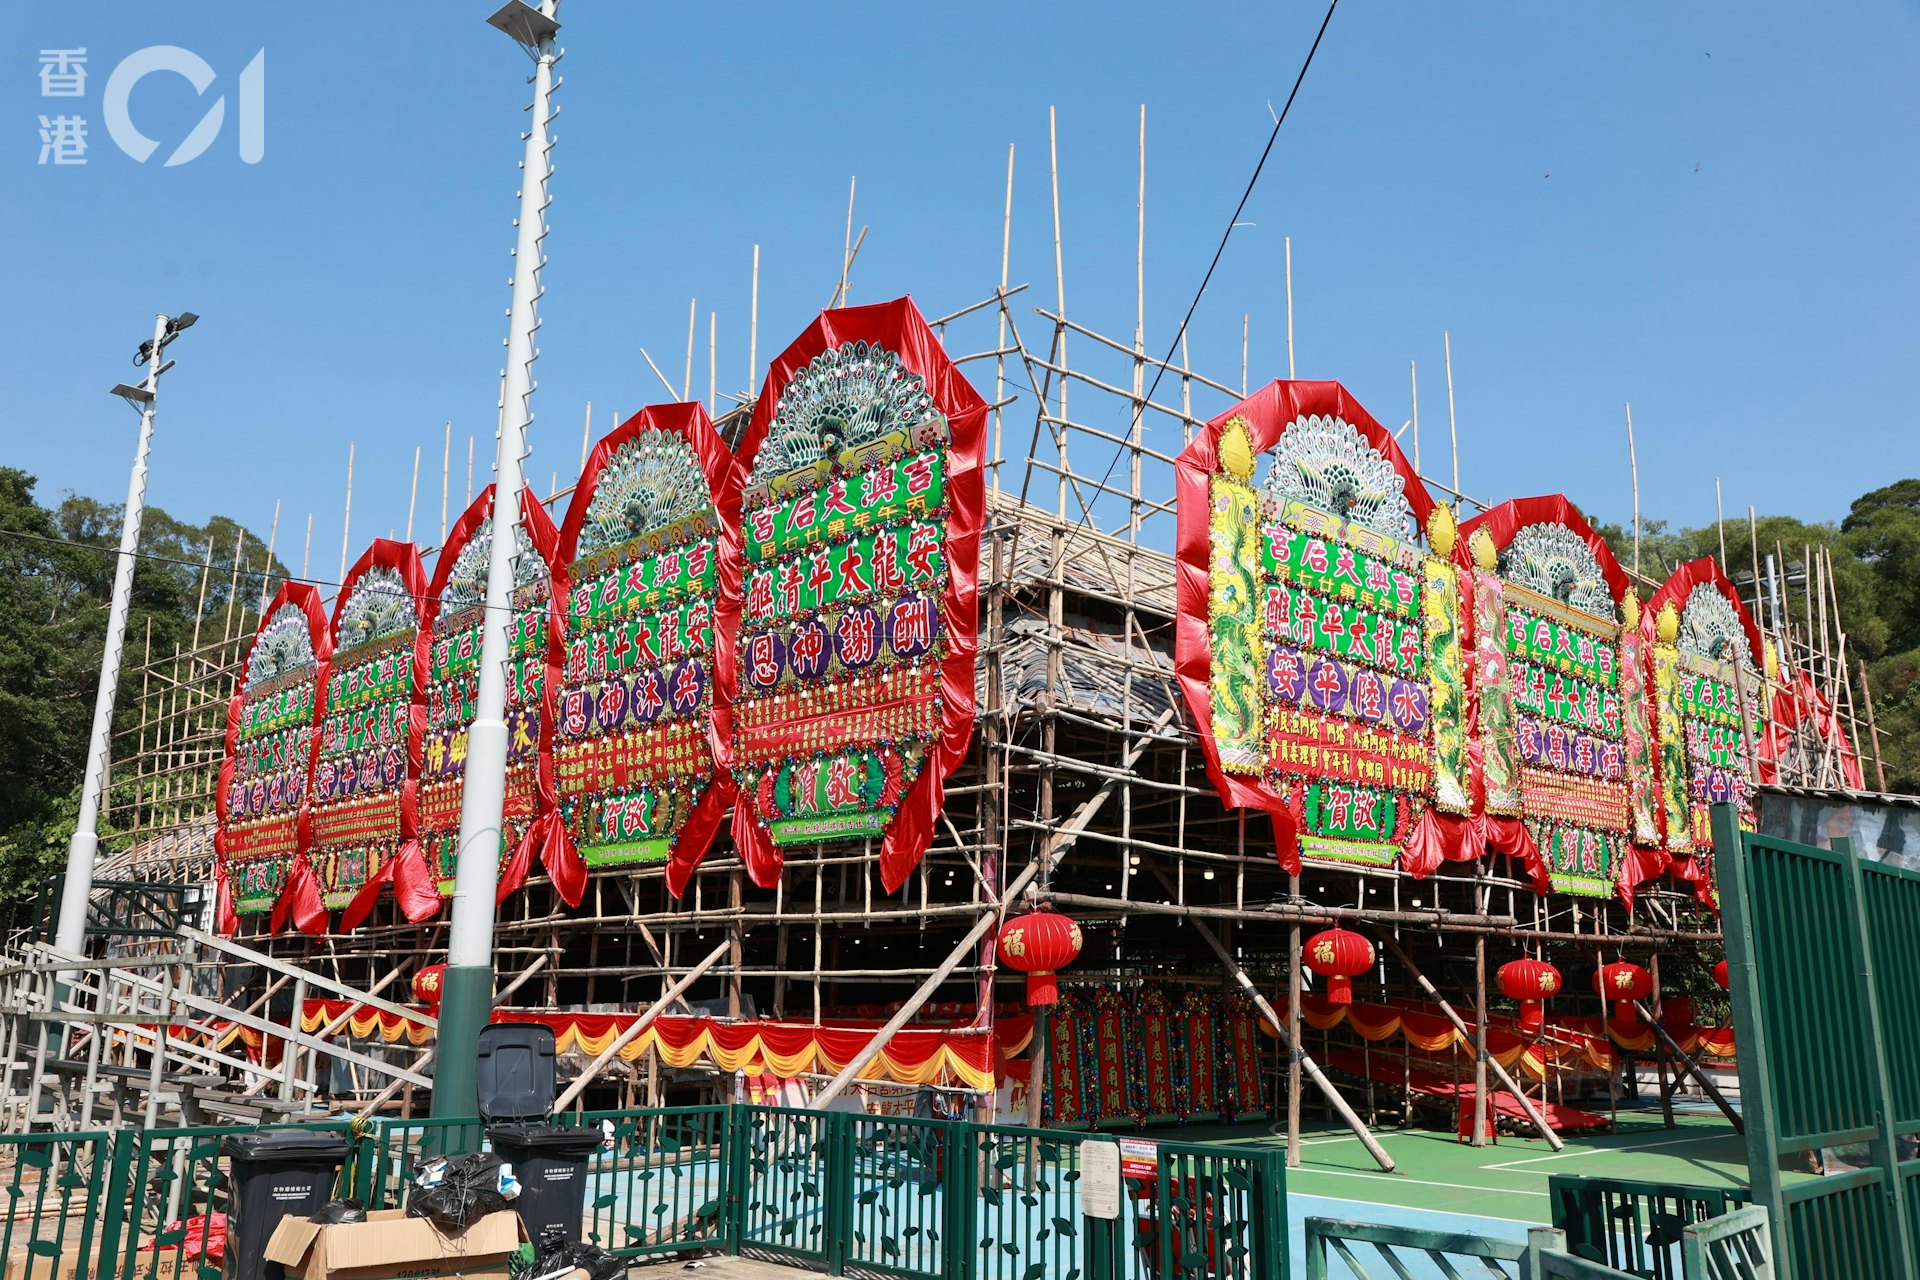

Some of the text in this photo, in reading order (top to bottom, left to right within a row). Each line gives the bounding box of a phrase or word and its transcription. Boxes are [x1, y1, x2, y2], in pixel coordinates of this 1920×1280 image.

[1002, 928, 1026, 958] 福
[1313, 940, 1335, 965] 福
[420, 972, 439, 992] 福
[1537, 970, 1555, 992] 福
[1614, 970, 1635, 990] 福
[1055, 1020, 1076, 1113] 福澤萬家
[1193, 1019, 1209, 1105] 水陸平安
